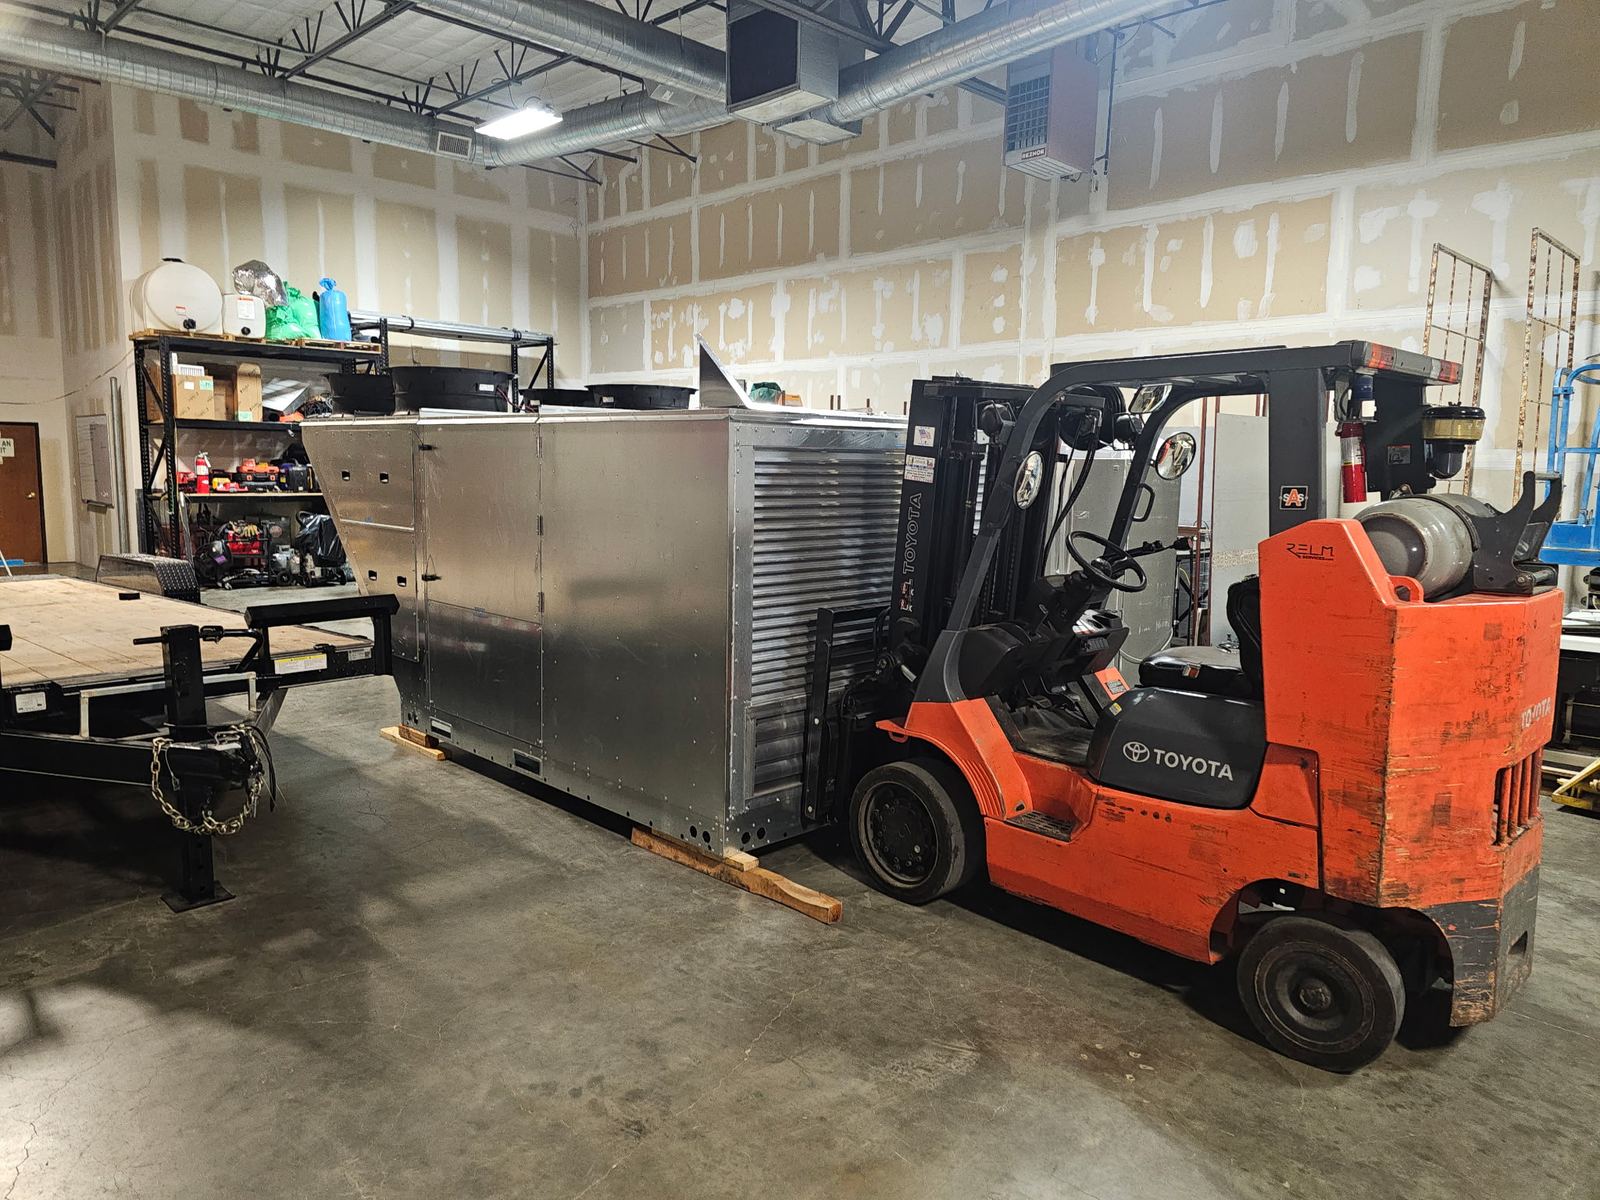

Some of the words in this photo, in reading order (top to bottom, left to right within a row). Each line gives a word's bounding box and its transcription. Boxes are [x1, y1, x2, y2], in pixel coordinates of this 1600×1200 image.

[903, 493, 922, 574] TOYOTA
[1286, 543, 1334, 558] RELM
[1153, 748, 1234, 781] TOYOTA
